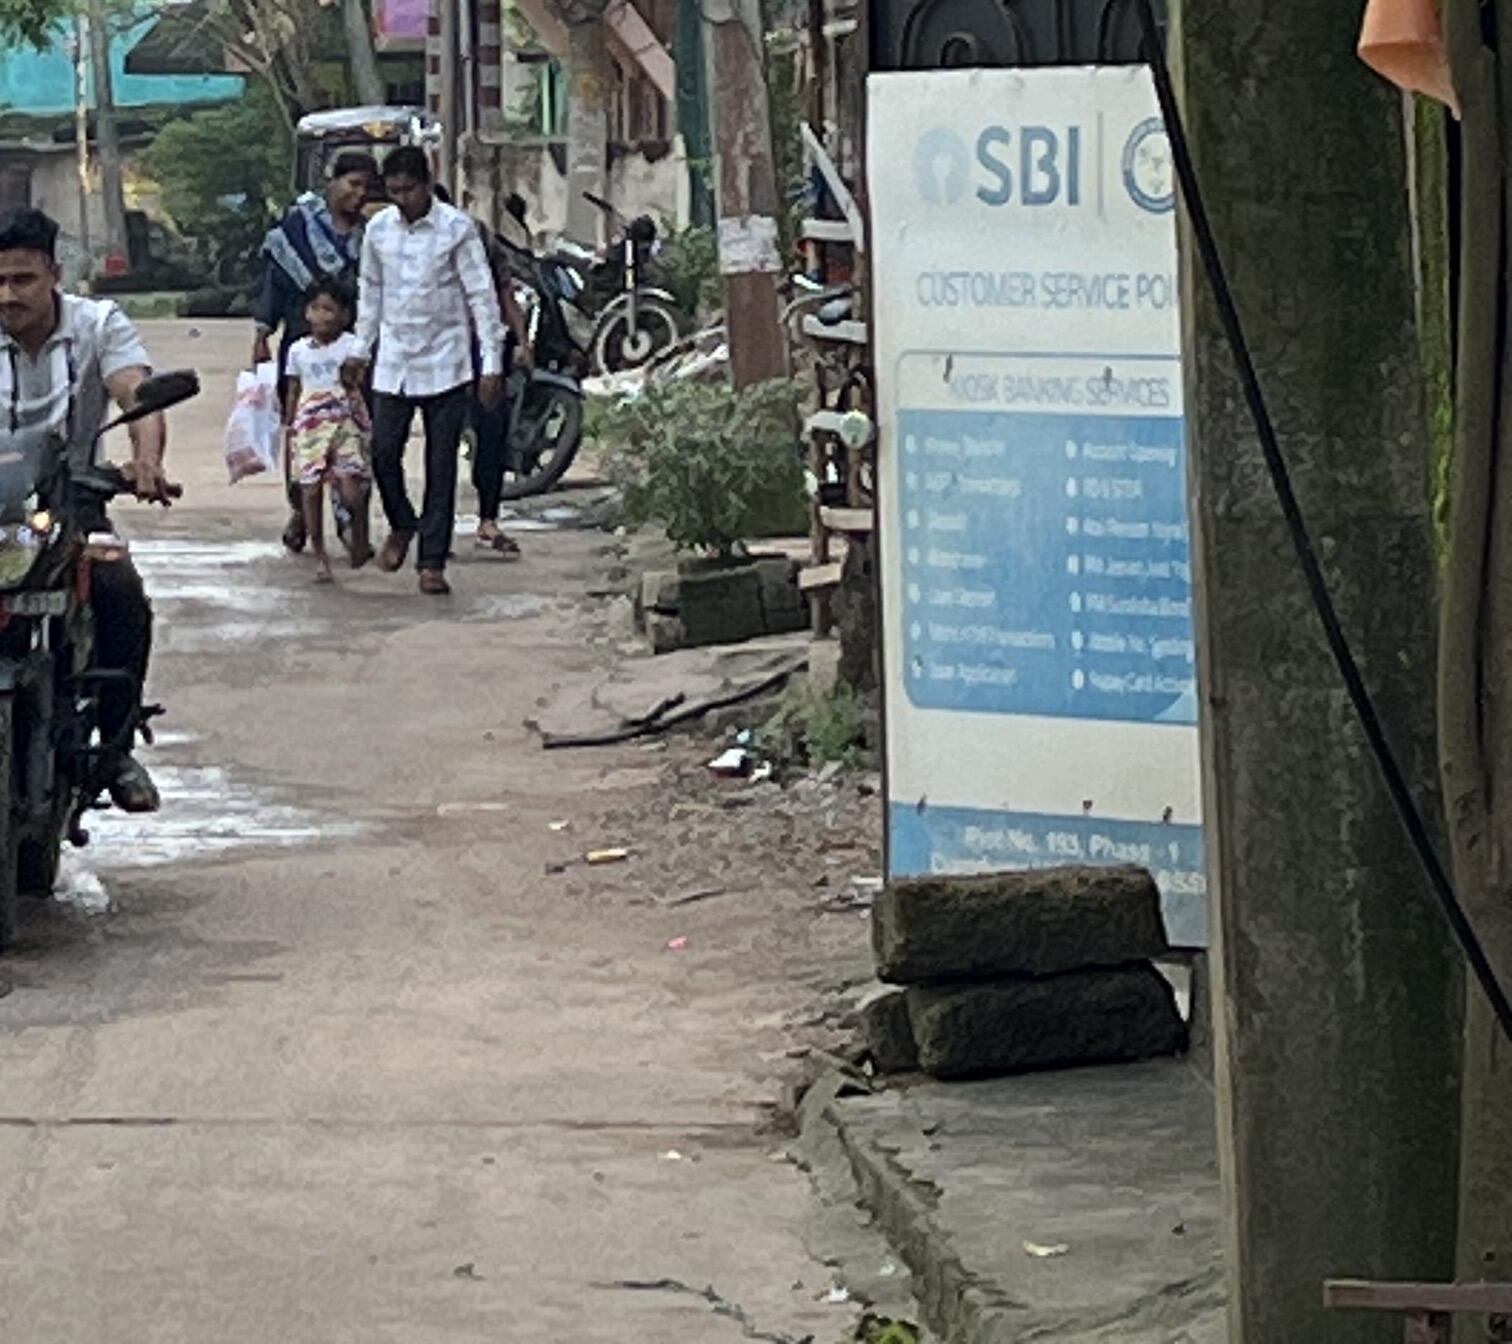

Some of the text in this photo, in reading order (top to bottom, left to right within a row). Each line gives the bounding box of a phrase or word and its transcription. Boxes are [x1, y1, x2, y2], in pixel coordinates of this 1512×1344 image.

[975, 125, 1081, 207] SBI
[917, 271, 1036, 307] CUSTOMER
[1040, 272, 1131, 310] SERVICE
[1085, 374, 1170, 408] SERVICES
